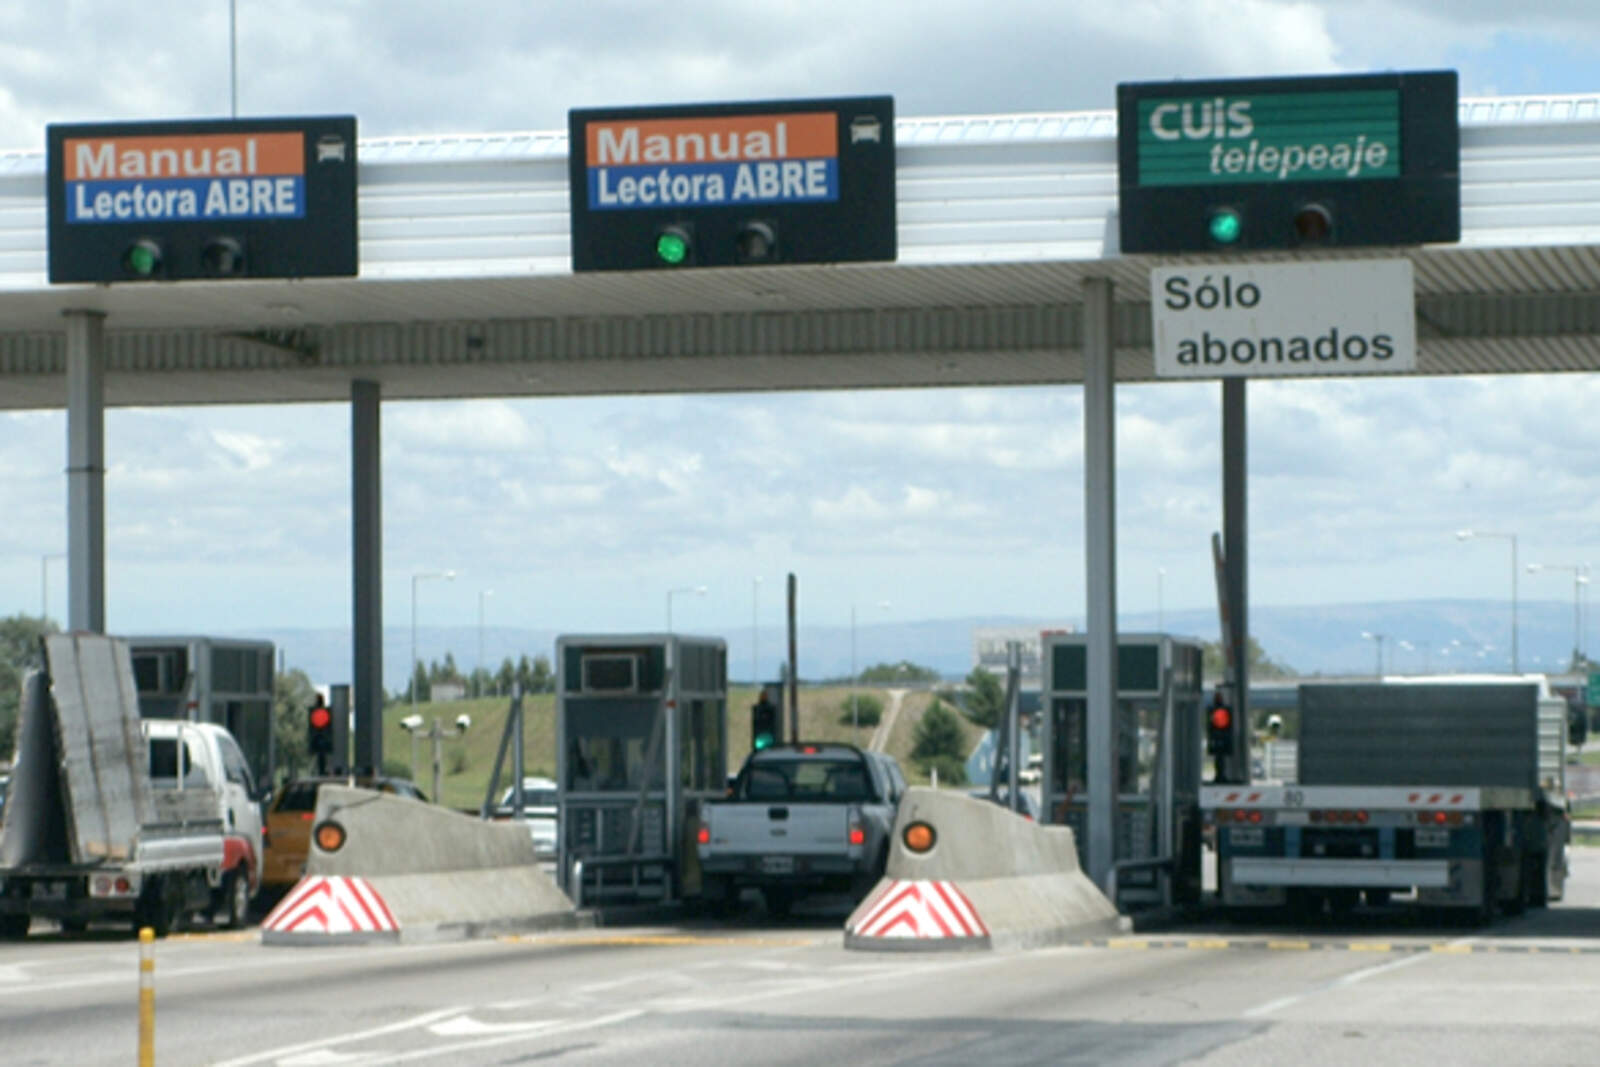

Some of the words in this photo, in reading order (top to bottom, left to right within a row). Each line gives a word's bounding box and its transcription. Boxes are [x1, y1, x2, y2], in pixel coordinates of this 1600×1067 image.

[76, 138, 256, 178] Manual
[598, 122, 787, 163] Manual
[1210, 136, 1388, 179] telepeaje
[76, 182, 197, 219] Lectora
[204, 178, 296, 215] ABRE
[598, 168, 725, 204] Lectora
[732, 161, 828, 200] ABRE
[1164, 275, 1262, 311] Sólo
[1176, 328, 1395, 366] abonados
